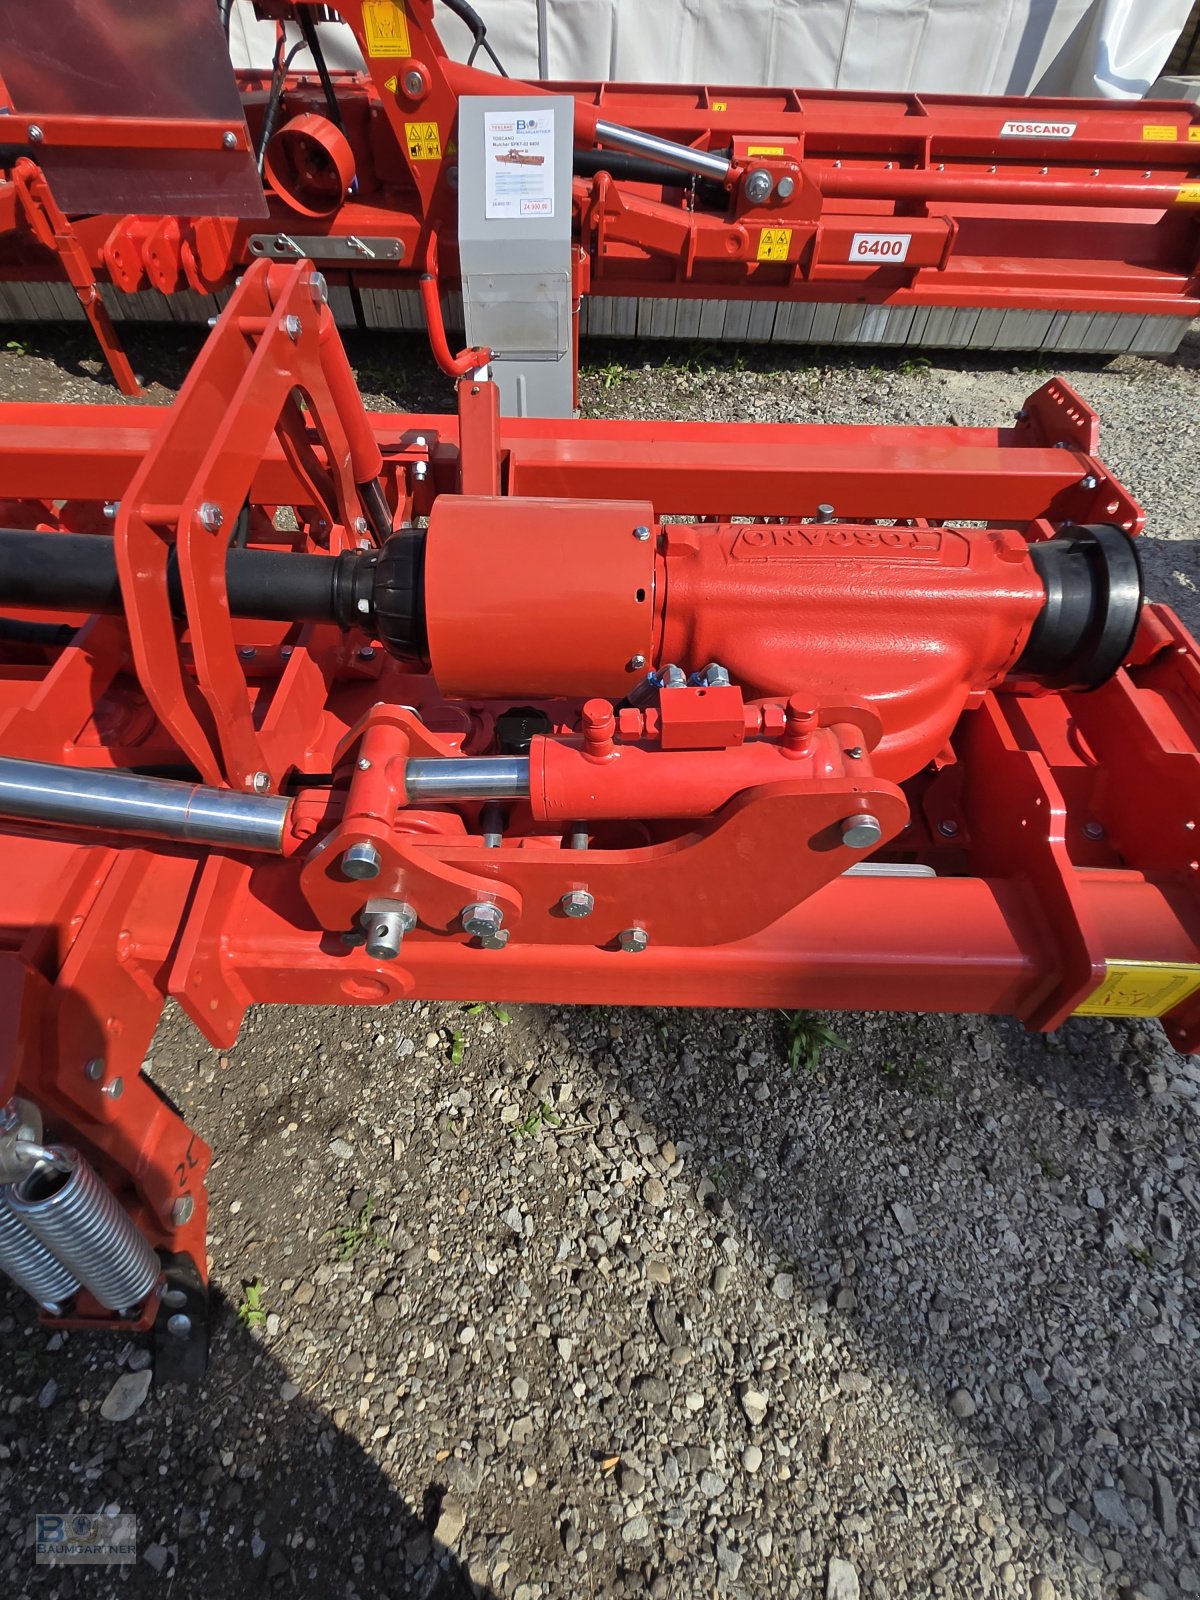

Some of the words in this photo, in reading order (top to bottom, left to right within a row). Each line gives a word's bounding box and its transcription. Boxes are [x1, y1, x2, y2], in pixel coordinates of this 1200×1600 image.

[1007, 124, 1070, 134] TOSCANO
[857, 240, 903, 256] 6400
[742, 529, 937, 549] TOSCANO
